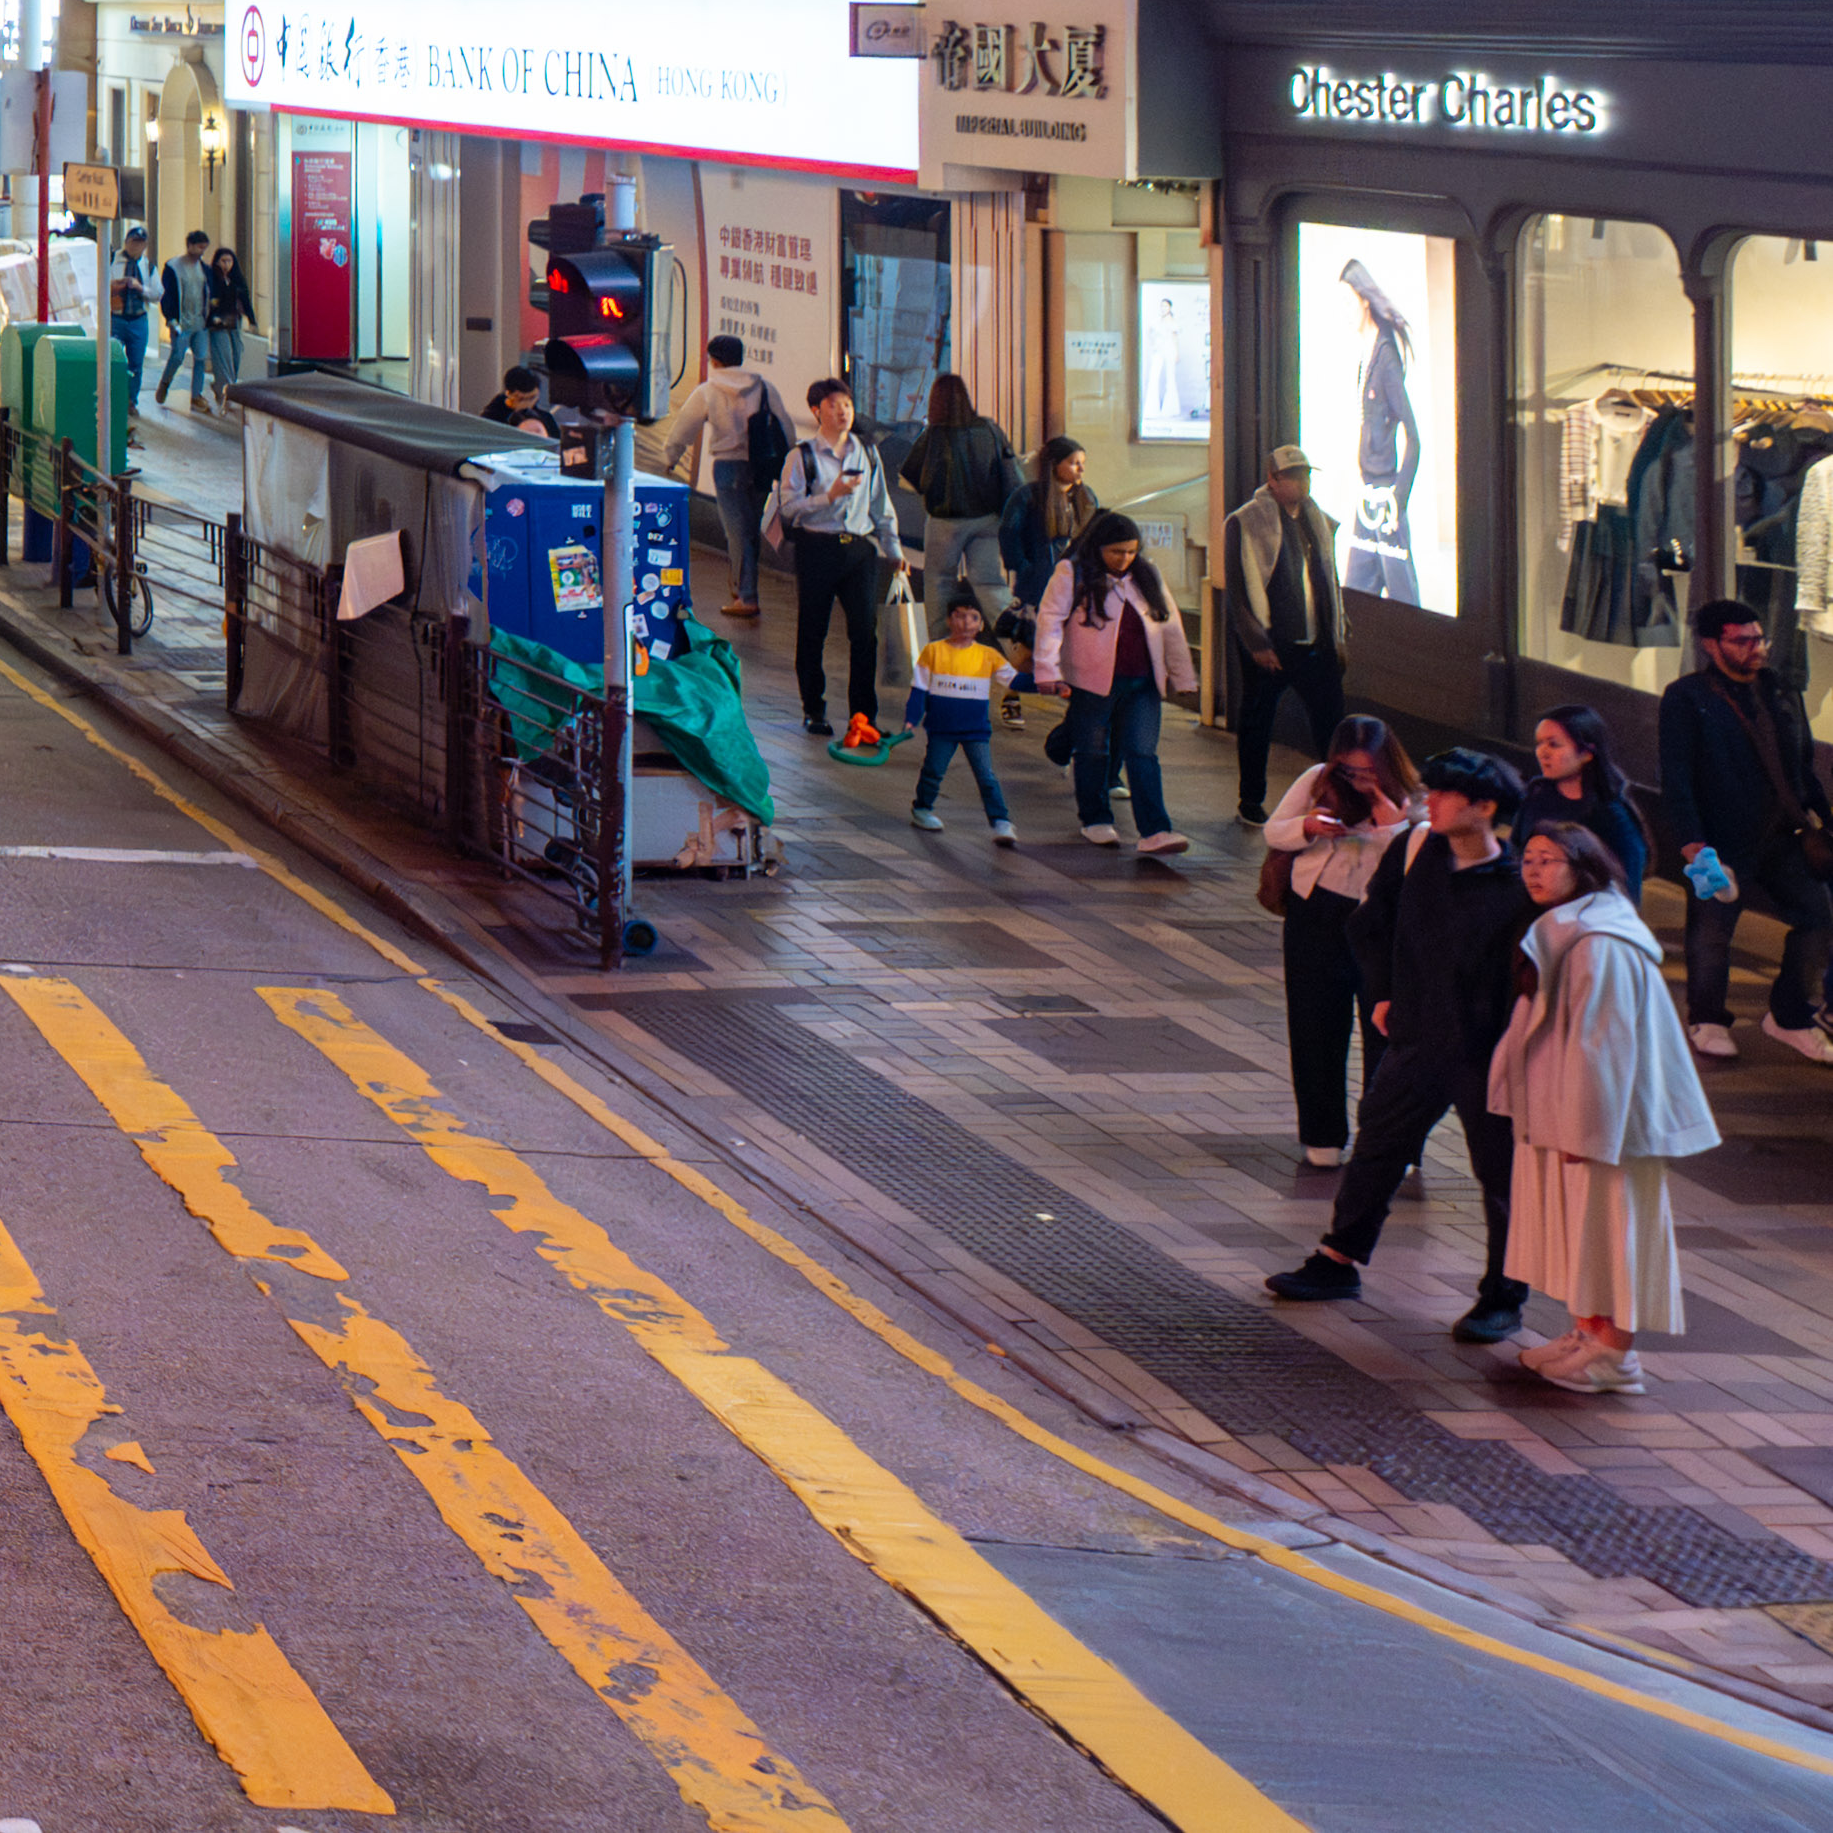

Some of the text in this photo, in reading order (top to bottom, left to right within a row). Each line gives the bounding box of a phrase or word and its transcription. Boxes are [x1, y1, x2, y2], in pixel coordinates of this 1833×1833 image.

[428, 43, 493, 91] BANK
[502, 46, 534, 96] OF
[544, 48, 639, 103] CHINA
[933, 19, 1108, 100] 帝國大廈
[1289, 66, 1601, 134] Chester Charles
